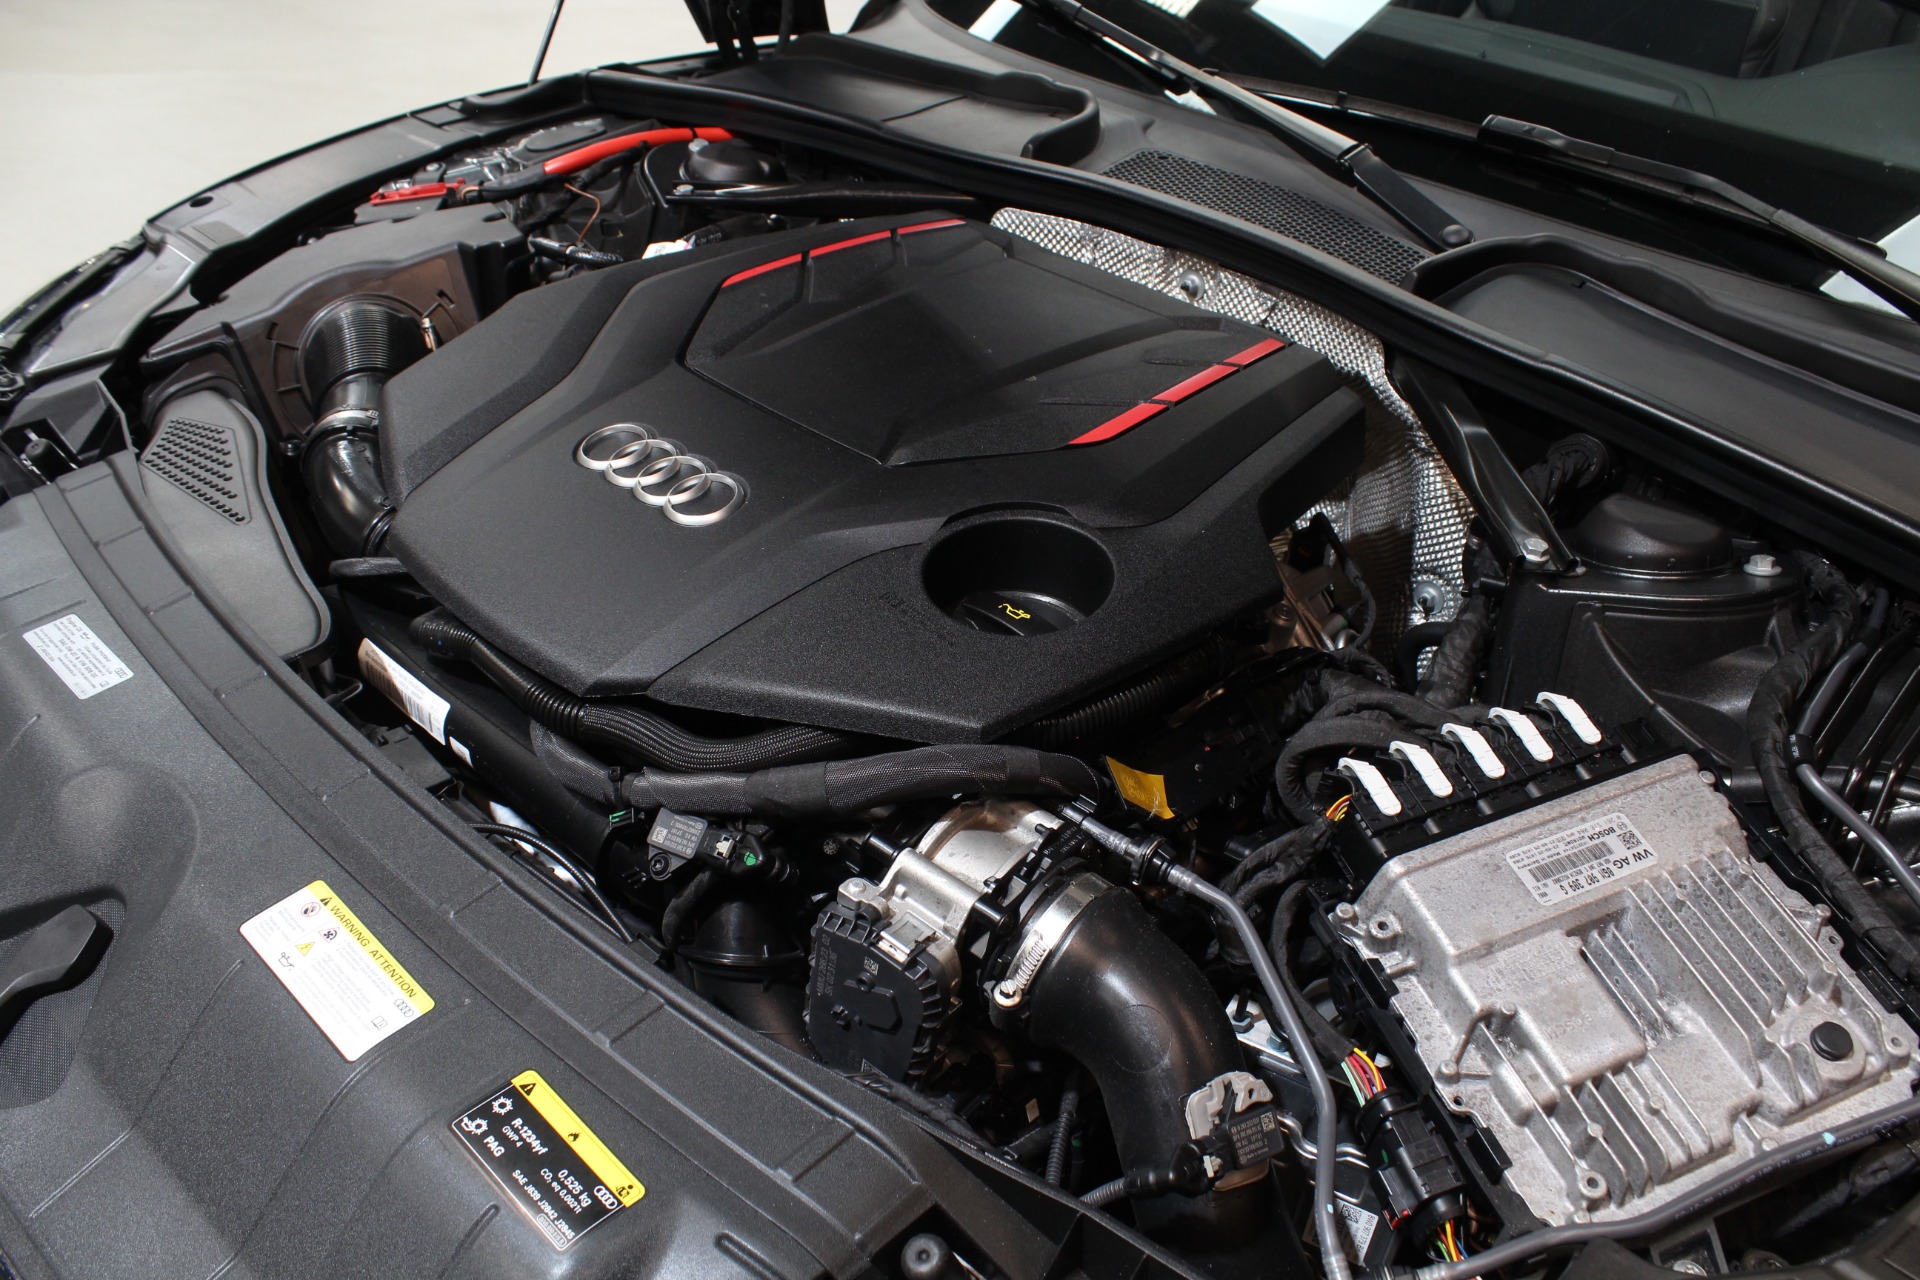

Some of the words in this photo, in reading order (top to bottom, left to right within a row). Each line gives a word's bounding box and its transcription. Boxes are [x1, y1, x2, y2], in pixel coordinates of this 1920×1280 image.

[1587, 826, 1616, 841] BOSCH
[1613, 856, 1630, 869] AG
[1632, 849, 1653, 862] VW
[1568, 878, 1584, 892] 309
[1584, 873, 1600, 886] 907
[1559, 884, 1568, 895] G
[331, 906, 369, 947] WARNING
[369, 950, 416, 998] ATTENTION
[502, 1126, 519, 1141] GWP
[512, 1118, 548, 1154] R-1234yf
[484, 1136, 504, 1157] PAG
[551, 1181, 561, 1192] eq
[558, 1169, 583, 1194] 0,525
[579, 1192, 592, 1207] kg
[512, 1170, 528, 1185] SAE
[524, 1185, 541, 1200] J639
[538, 1200, 558, 1220] J2842
[554, 1219, 575, 1239] J2845
